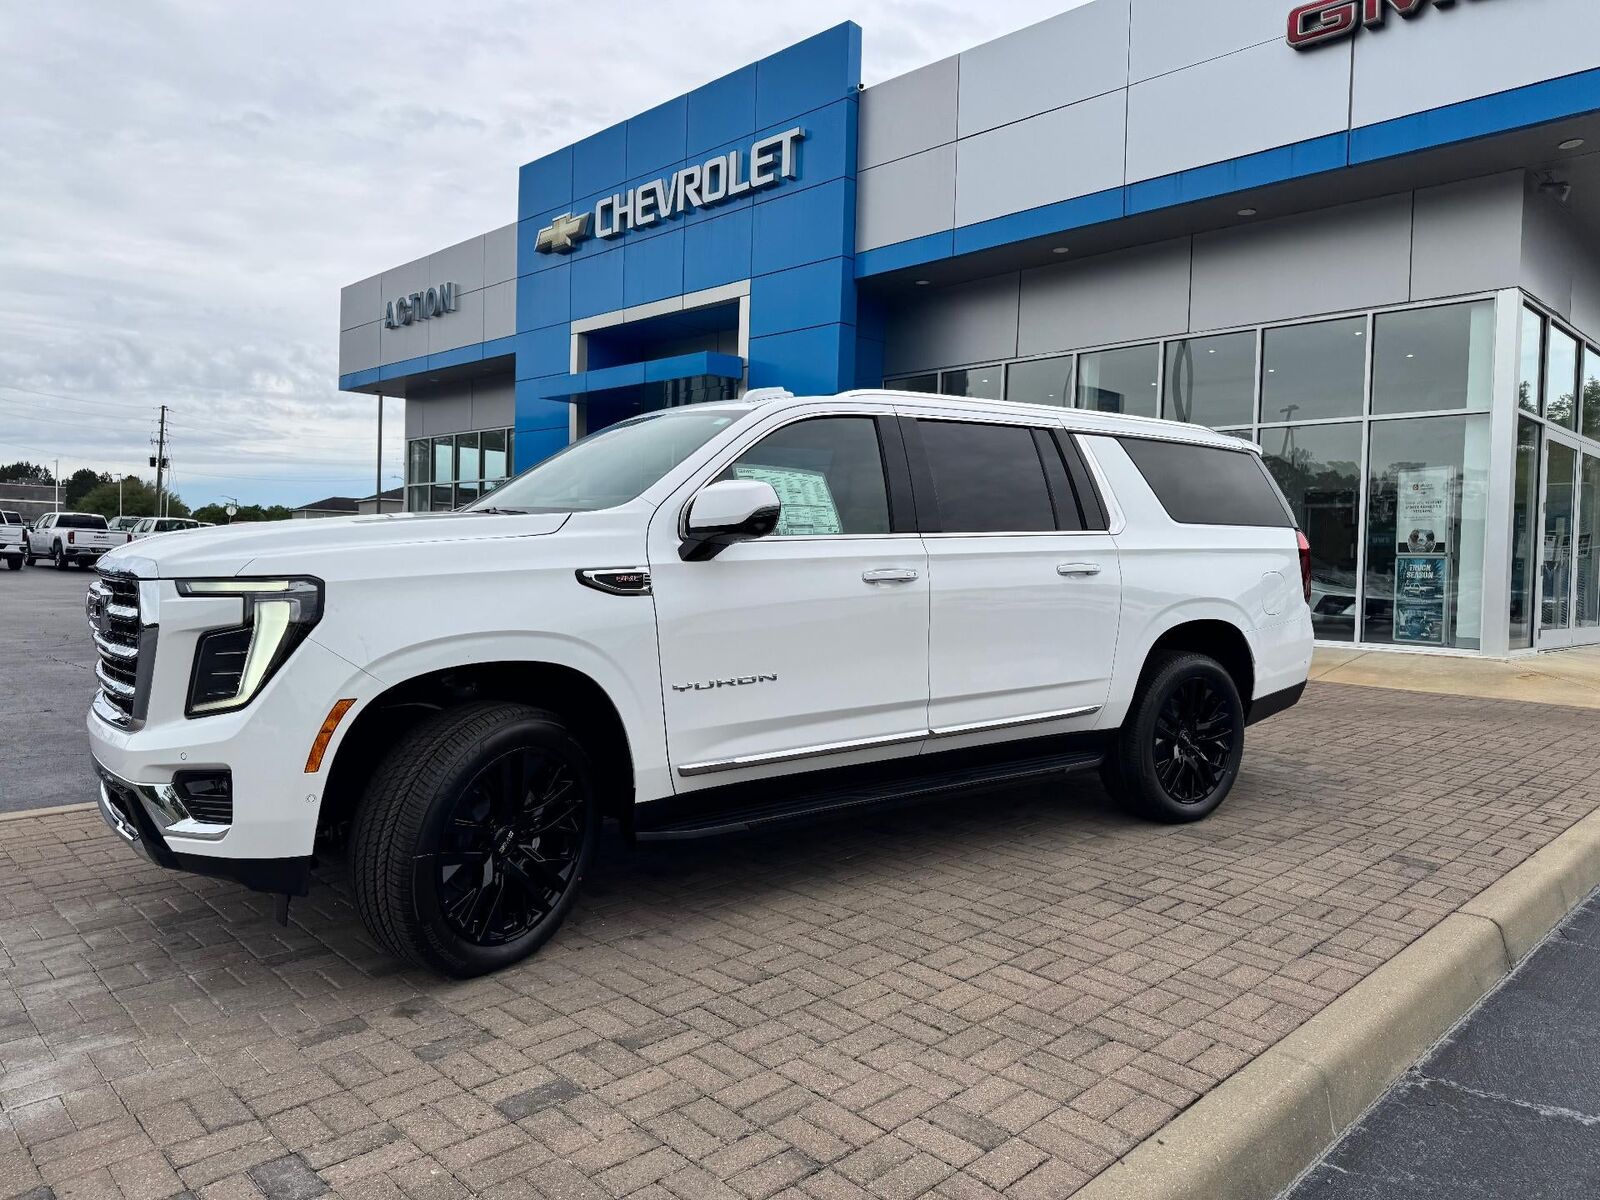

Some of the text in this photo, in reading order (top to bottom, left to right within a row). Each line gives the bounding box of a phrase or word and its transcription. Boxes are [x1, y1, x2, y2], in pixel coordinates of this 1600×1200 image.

[594, 126, 806, 239] CHEVROLET
[385, 281, 456, 328] ACTION
[1406, 571, 1434, 579] SEASON
[1409, 564, 1432, 572] TRUCK
[671, 672, 778, 692] YUKON
